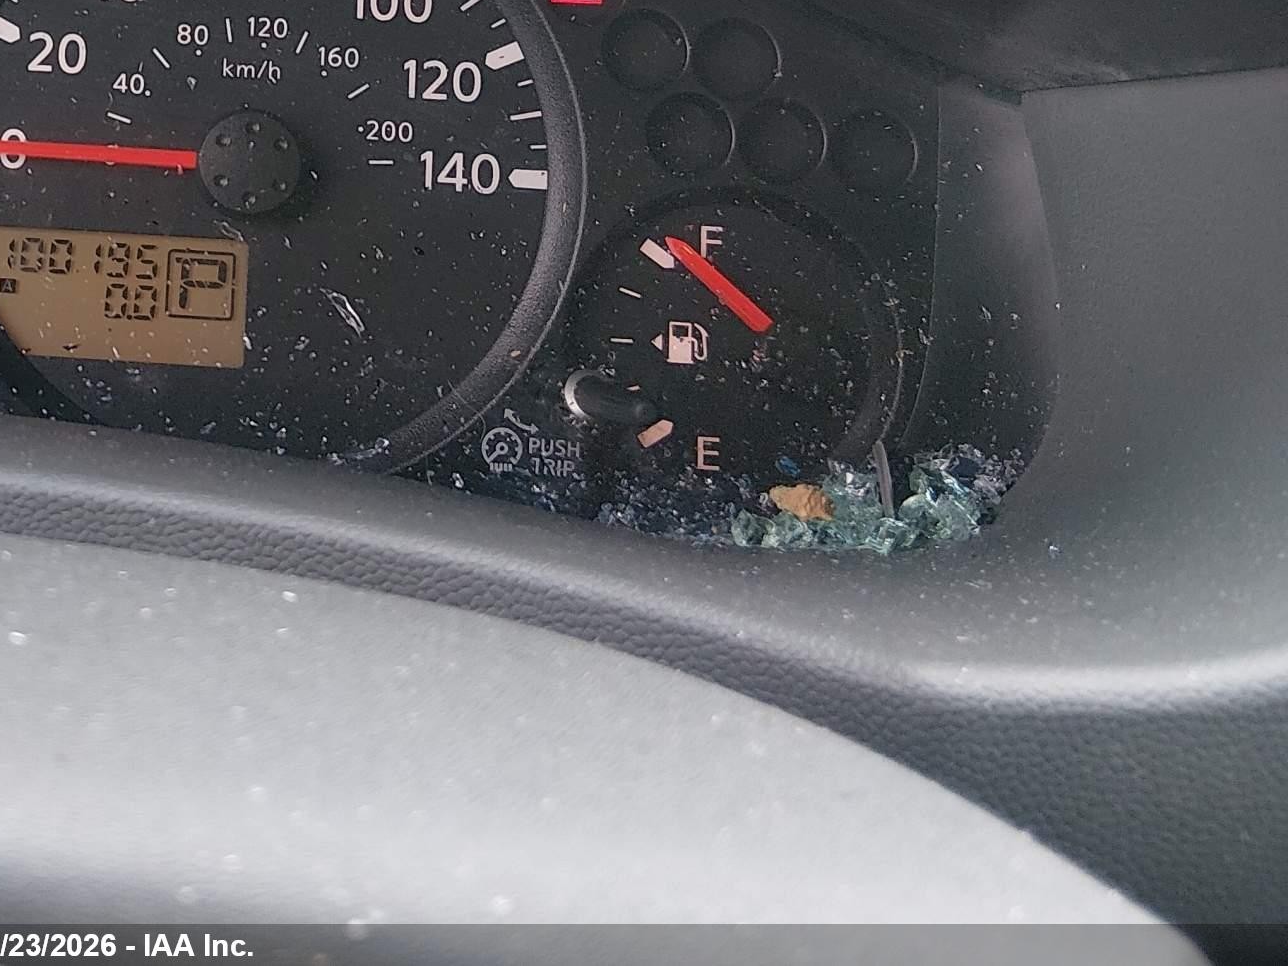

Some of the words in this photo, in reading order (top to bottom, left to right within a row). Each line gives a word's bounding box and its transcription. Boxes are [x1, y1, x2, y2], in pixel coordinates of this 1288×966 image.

[177, 24, 209, 46] 80
[247, 17, 289, 40] 120
[27, 33, 87, 74] 20
[317, 46, 360, 69] 160
[222, 58, 282, 84] km/h
[403, 59, 483, 103] 120
[365, 121, 413, 143] 200
[0, 128, 27, 170] 0
[419, 150, 501, 195] 140
[700, 225, 723, 258] F
[175, 257, 228, 310] P
[527, 438, 581, 459] PUSH
[696, 436, 720, 471] E
[529, 457, 576, 477] TRIP
